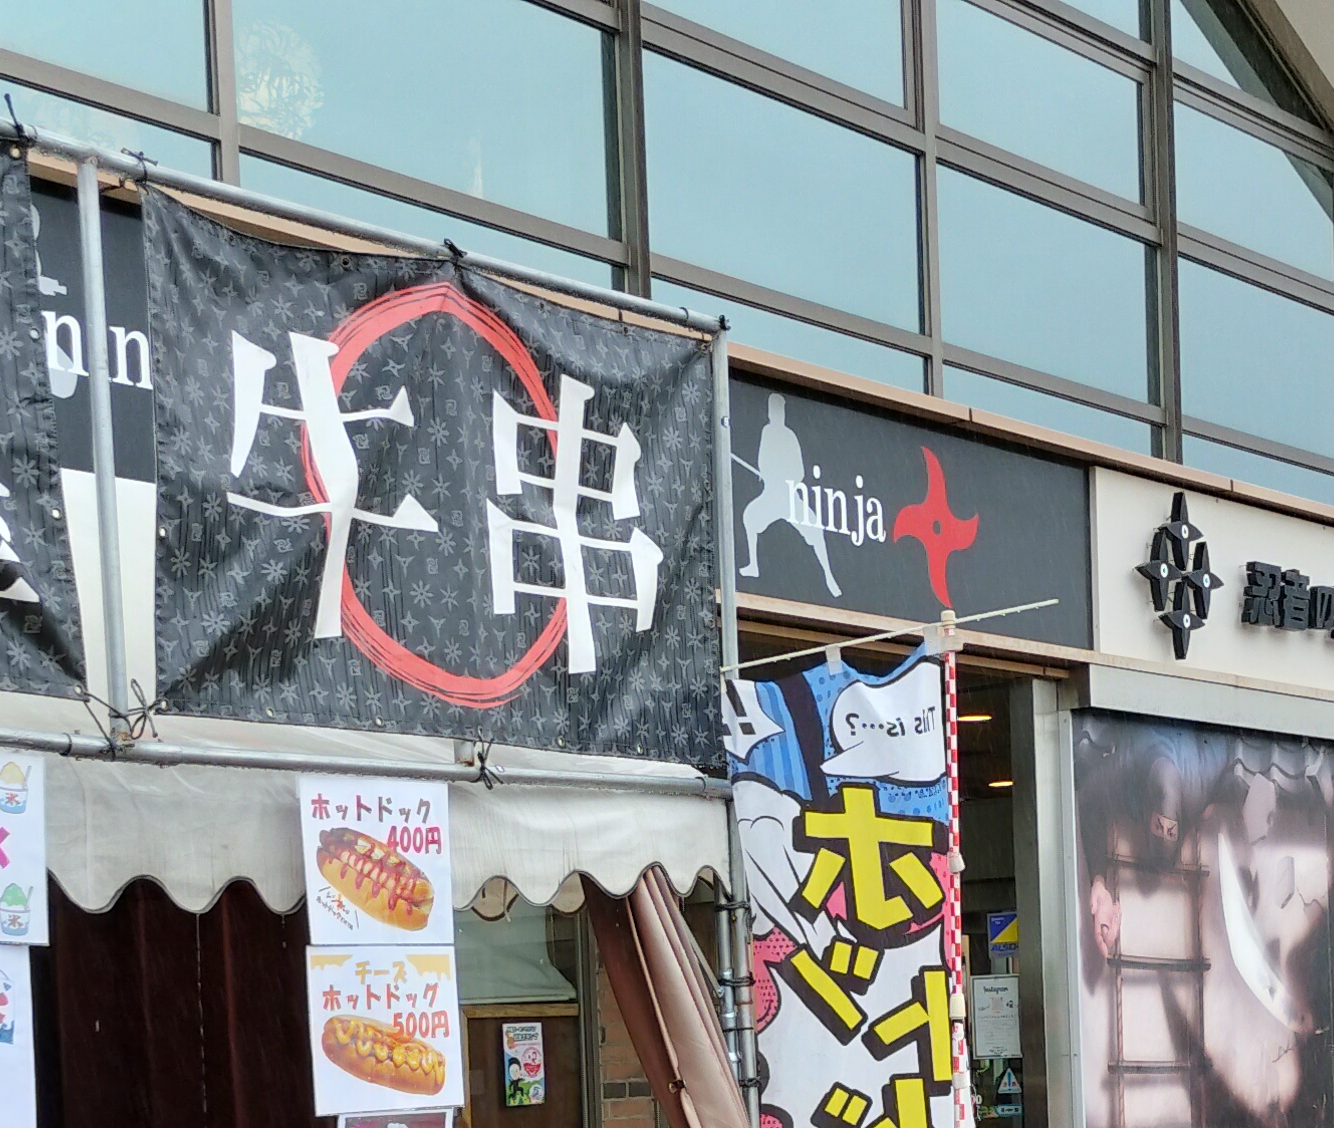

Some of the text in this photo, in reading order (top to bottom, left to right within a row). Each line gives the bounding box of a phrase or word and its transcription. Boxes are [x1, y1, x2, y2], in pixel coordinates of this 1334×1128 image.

[225, 330, 664, 675] 牛串
[784, 463, 888, 548] ninja
[310, 792, 432, 824] ホットドック
[386, 825, 443, 855] 400円
[322, 982, 439, 1011] ホットドック
[392, 1010, 450, 1039] 500円
